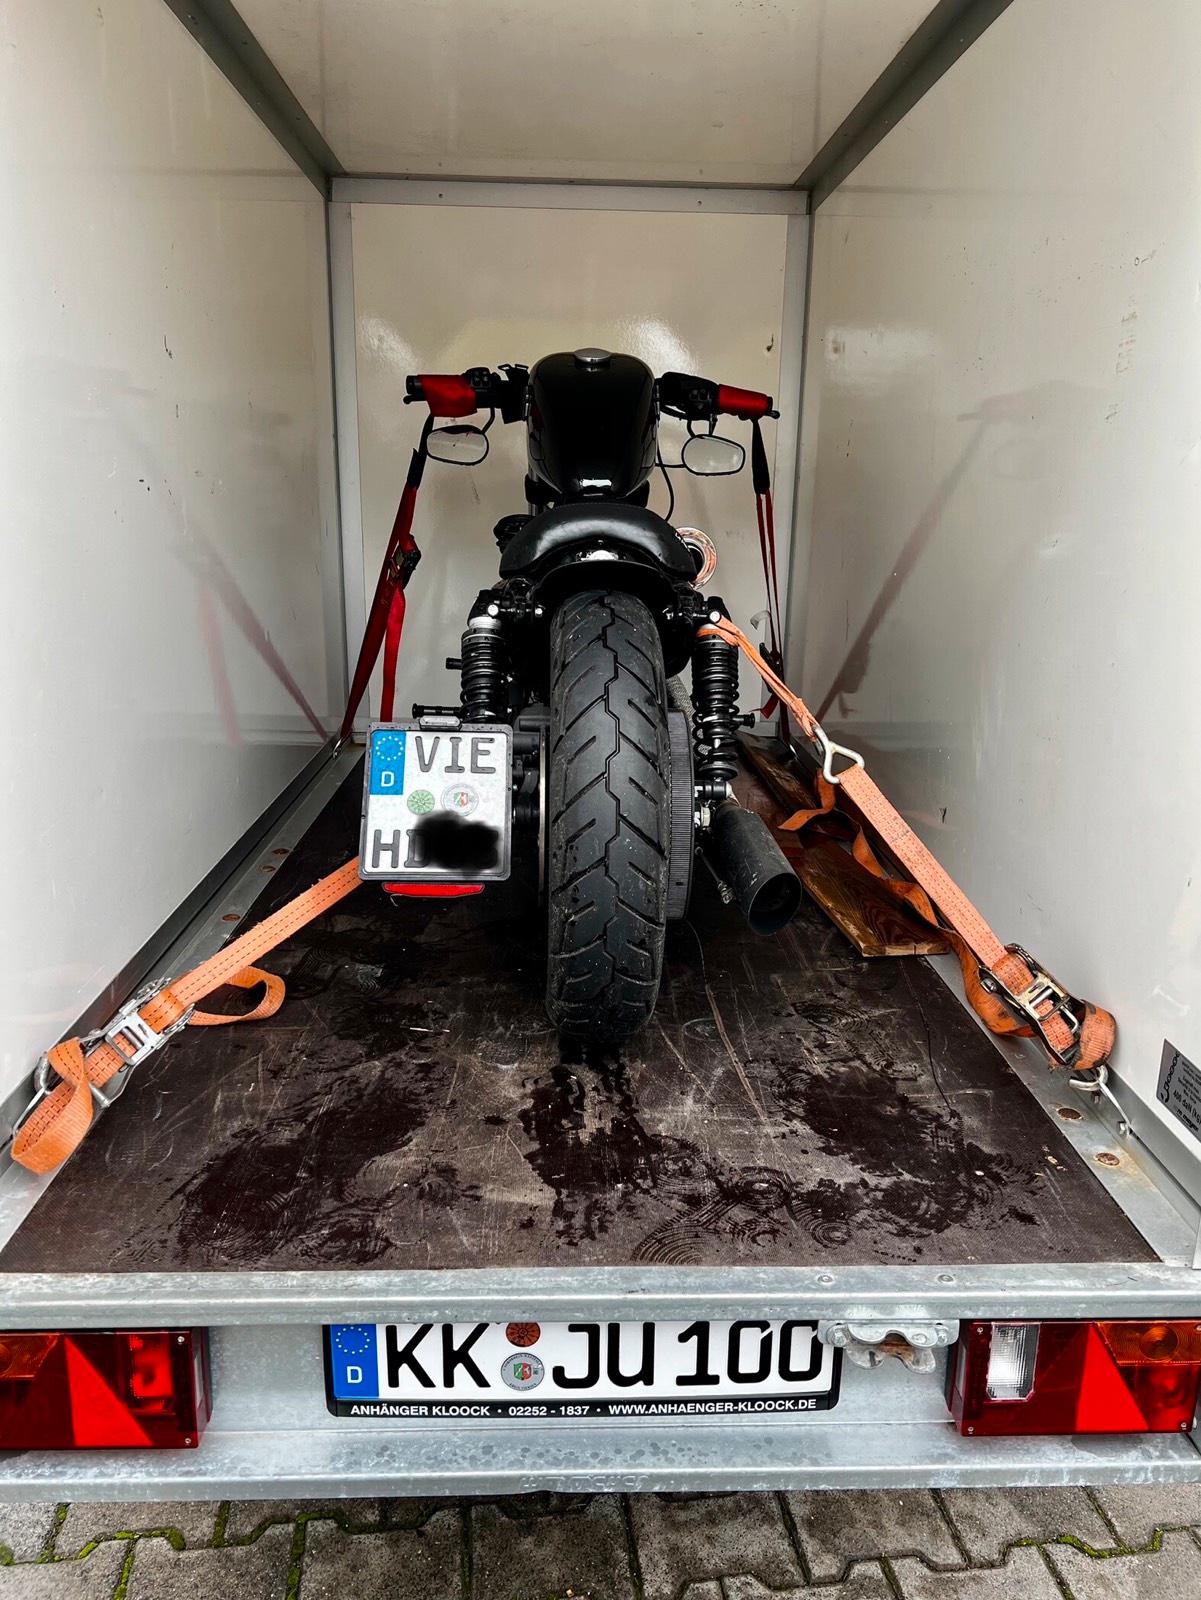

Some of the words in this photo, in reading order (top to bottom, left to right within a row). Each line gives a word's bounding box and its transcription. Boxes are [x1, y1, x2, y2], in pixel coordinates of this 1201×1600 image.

[415, 736, 497, 774] VIE
[380, 771, 395, 788] D
[385, 1322, 491, 1388] KK
[552, 1321, 655, 1389] JU
[675, 1320, 823, 1386] 100
[346, 1365, 363, 1384] D
[350, 1403, 429, 1416] ANHÄNGER
[432, 1405, 490, 1416] KLOOCK
[508, 1405, 547, 1416] 02252
[559, 1405, 590, 1416] 1837
[608, 1398, 817, 1416] WWW.ANHAENGER-KLOOCK.DE
